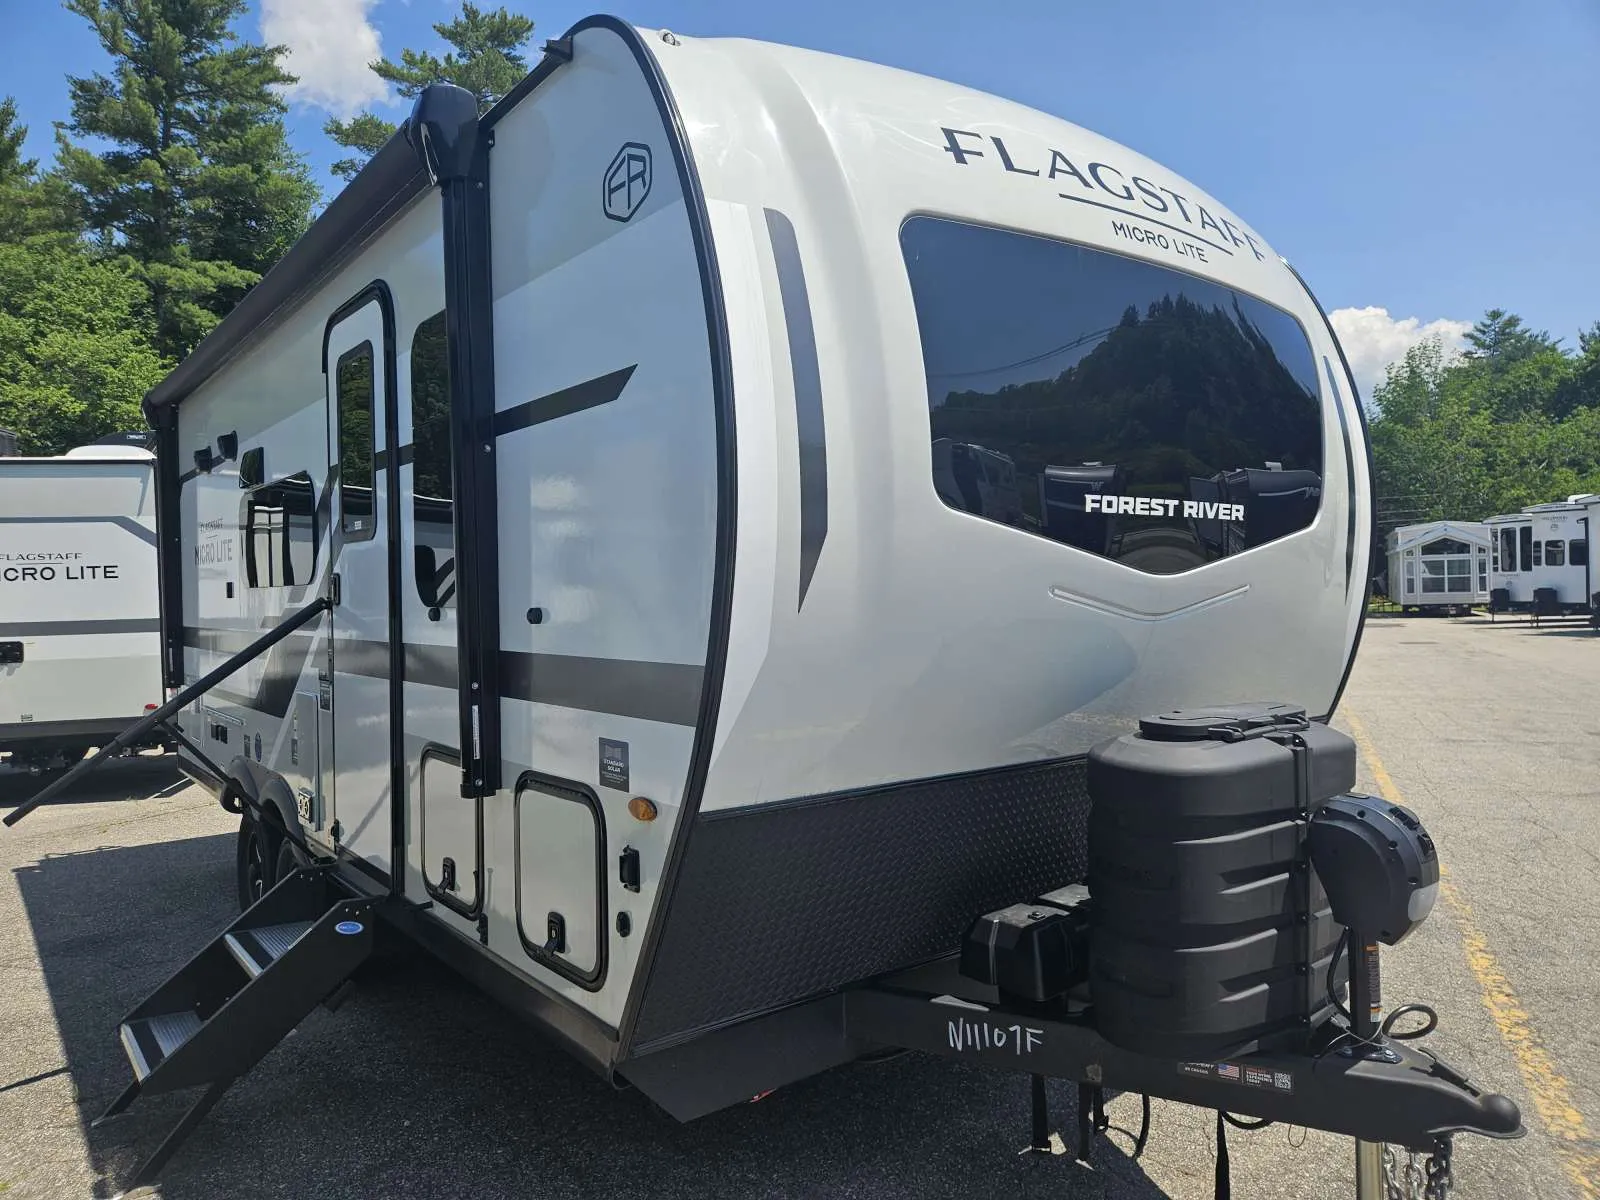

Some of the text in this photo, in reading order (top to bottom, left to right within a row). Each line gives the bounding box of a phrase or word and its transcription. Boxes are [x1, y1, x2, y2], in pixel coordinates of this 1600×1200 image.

[941, 127, 1266, 263] FLAGSTAFF
[1111, 220, 1209, 263] MICRO LITE
[1084, 494, 1245, 521] FOREST RIVER
[0, 565, 119, 581] CRO LITE
